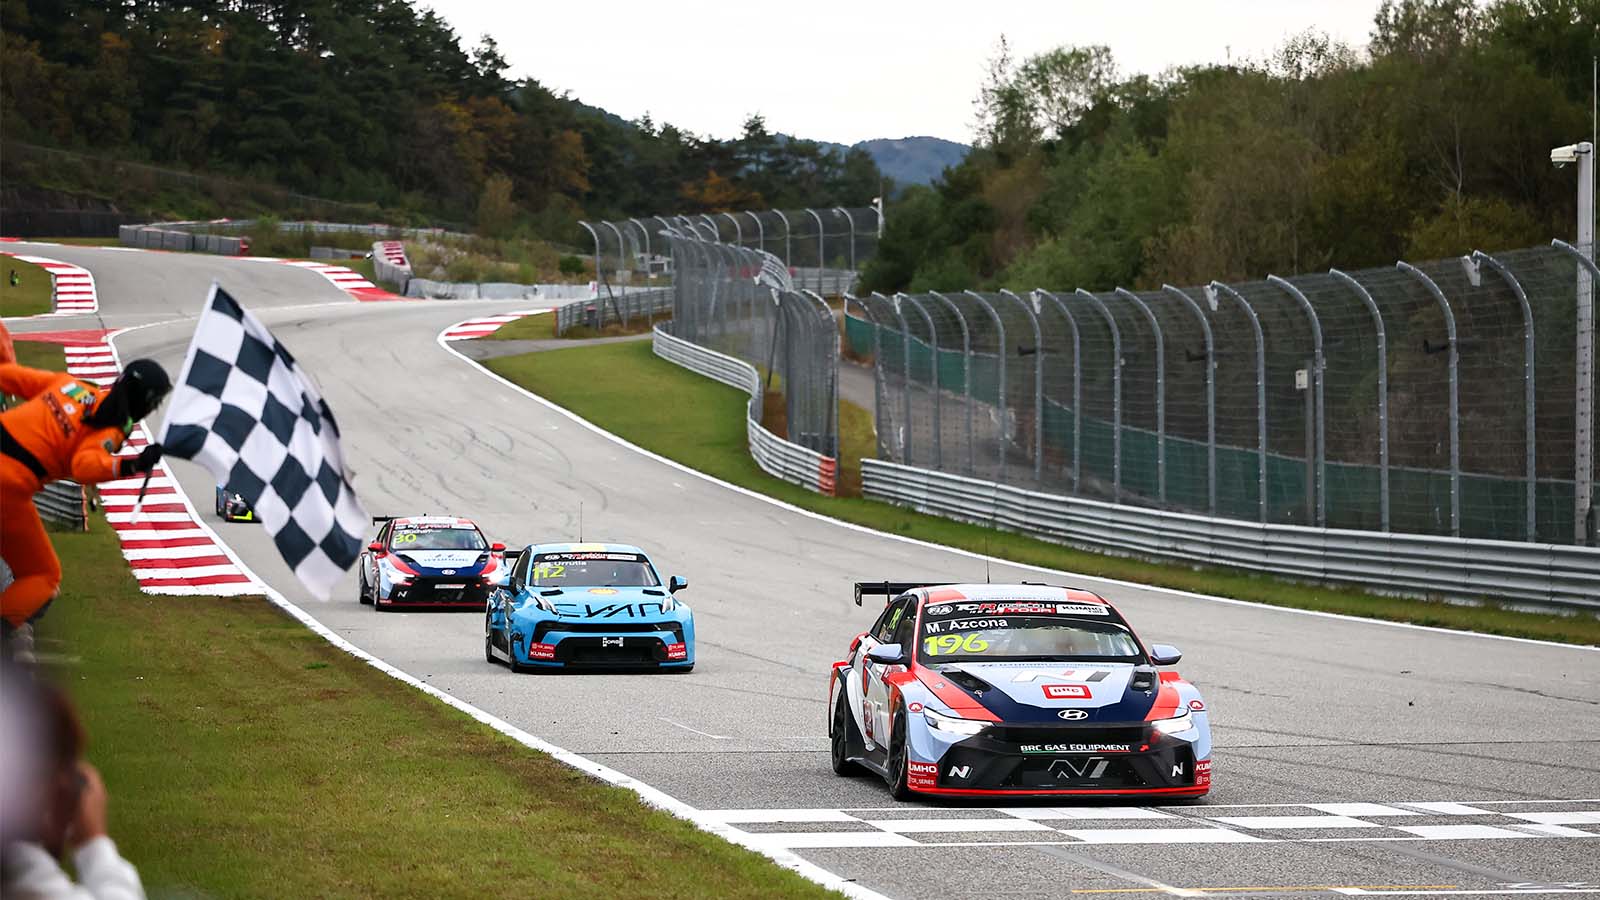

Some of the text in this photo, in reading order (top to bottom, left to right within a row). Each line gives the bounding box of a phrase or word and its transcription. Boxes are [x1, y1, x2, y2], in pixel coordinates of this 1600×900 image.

[395, 533, 417, 544] 30
[532, 565, 565, 580] 112
[928, 605, 953, 615] FIA
[926, 619, 1008, 634] M. Azcona
[924, 633, 989, 656] 196
[1020, 744, 1042, 752] BRC
[1070, 743, 1130, 752] EQUIPMENT
[908, 763, 937, 773] UMHO
